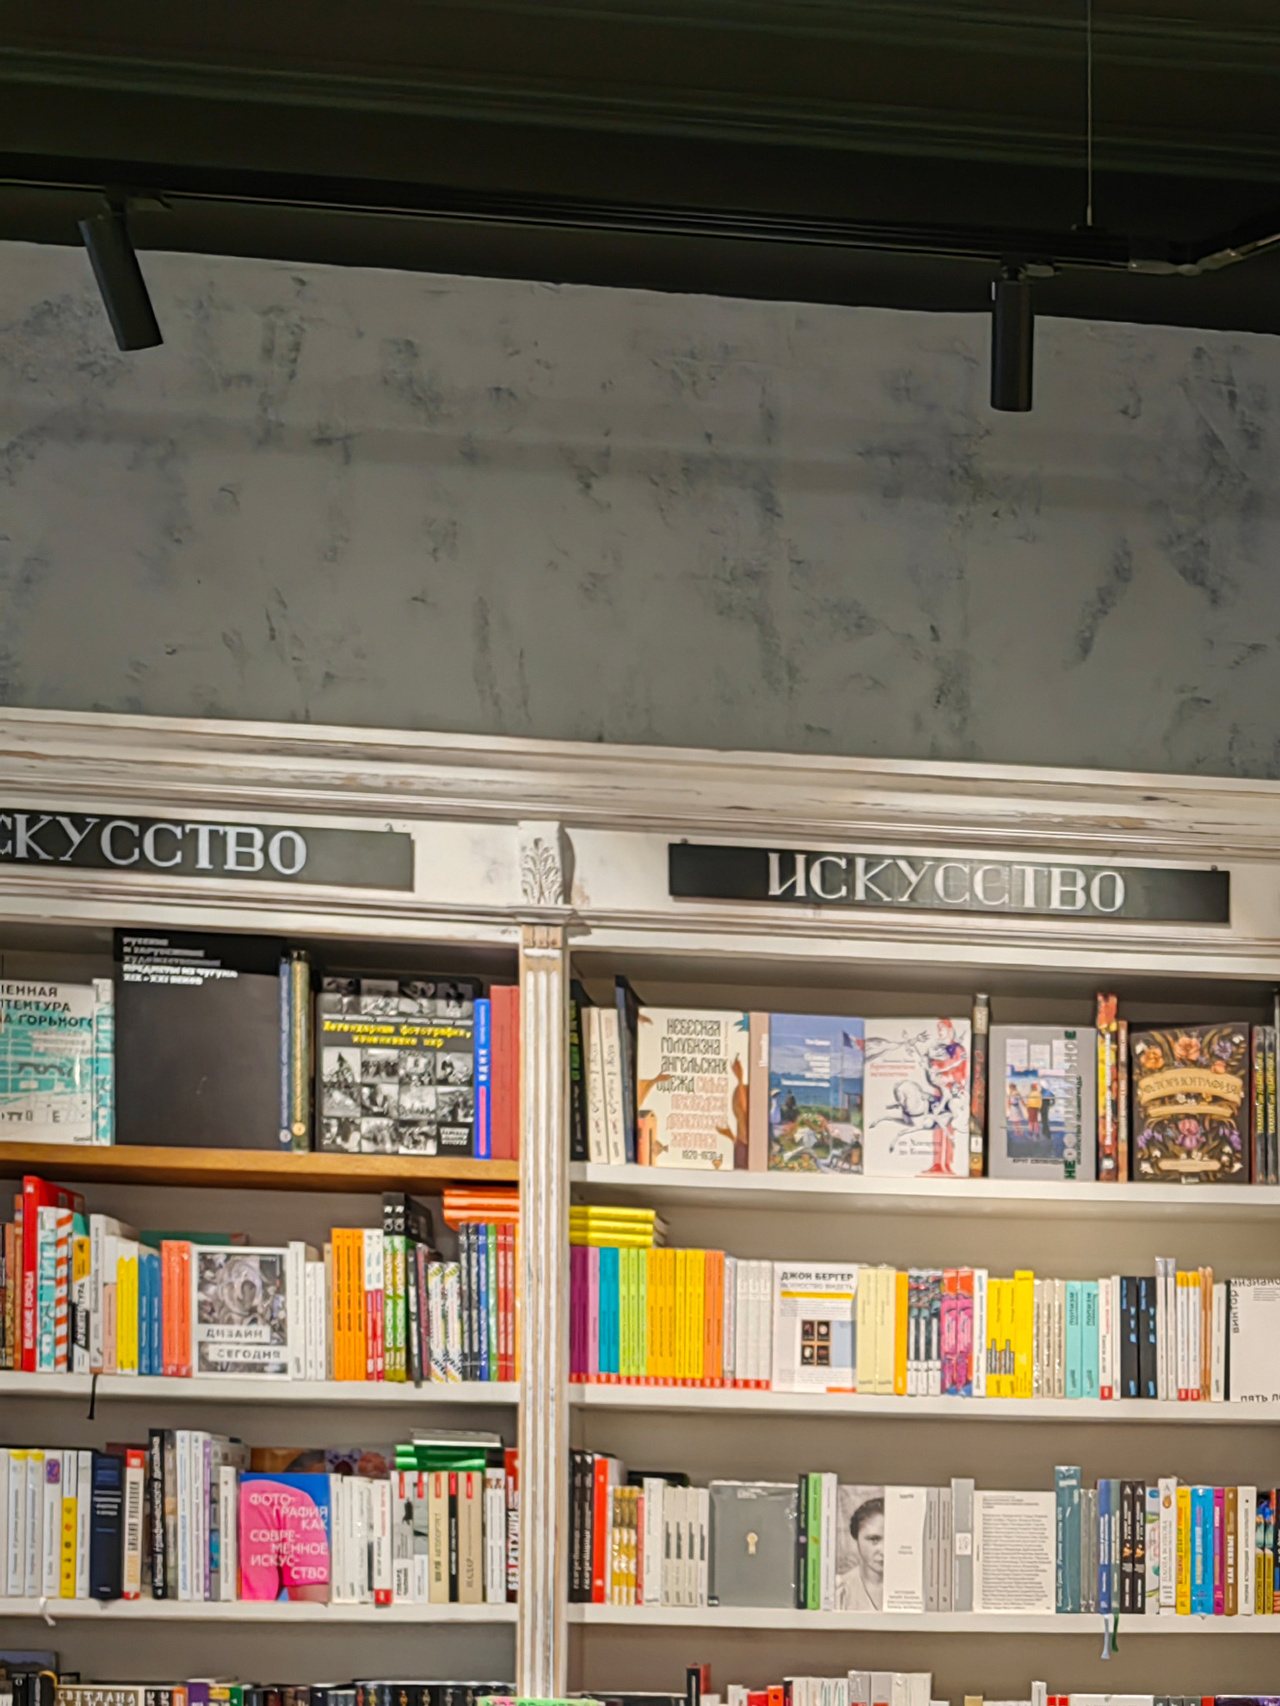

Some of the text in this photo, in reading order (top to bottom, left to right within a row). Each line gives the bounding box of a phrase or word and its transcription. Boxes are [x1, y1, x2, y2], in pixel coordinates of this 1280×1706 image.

[767, 851, 1126, 914] ИСКУССТВО
[666, 1018, 722, 1037] НЕБЕСНАЯ
[781, 1272, 854, 1283] ДЖОН БЕРГЕР
[206, 1328, 263, 1340] ДИЗАЙН
[217, 1349, 280, 1361] СЕГОДНЯ
[249, 1493, 296, 1506] ФОТО-
[272, 1505, 328, 1518] ГРАФИЯ
[301, 1519, 328, 1530] КАК
[249, 1530, 300, 1542] СОВРЕ-
[271, 1543, 328, 1555] МЕННОЕ
[250, 1554, 299, 1567] ИСКУС-
[290, 1567, 327, 1580] СТВО
[1227, 1567, 1235, 1584] КАК
[58, 1690, 136, 1702] СВЕТЛАНА
